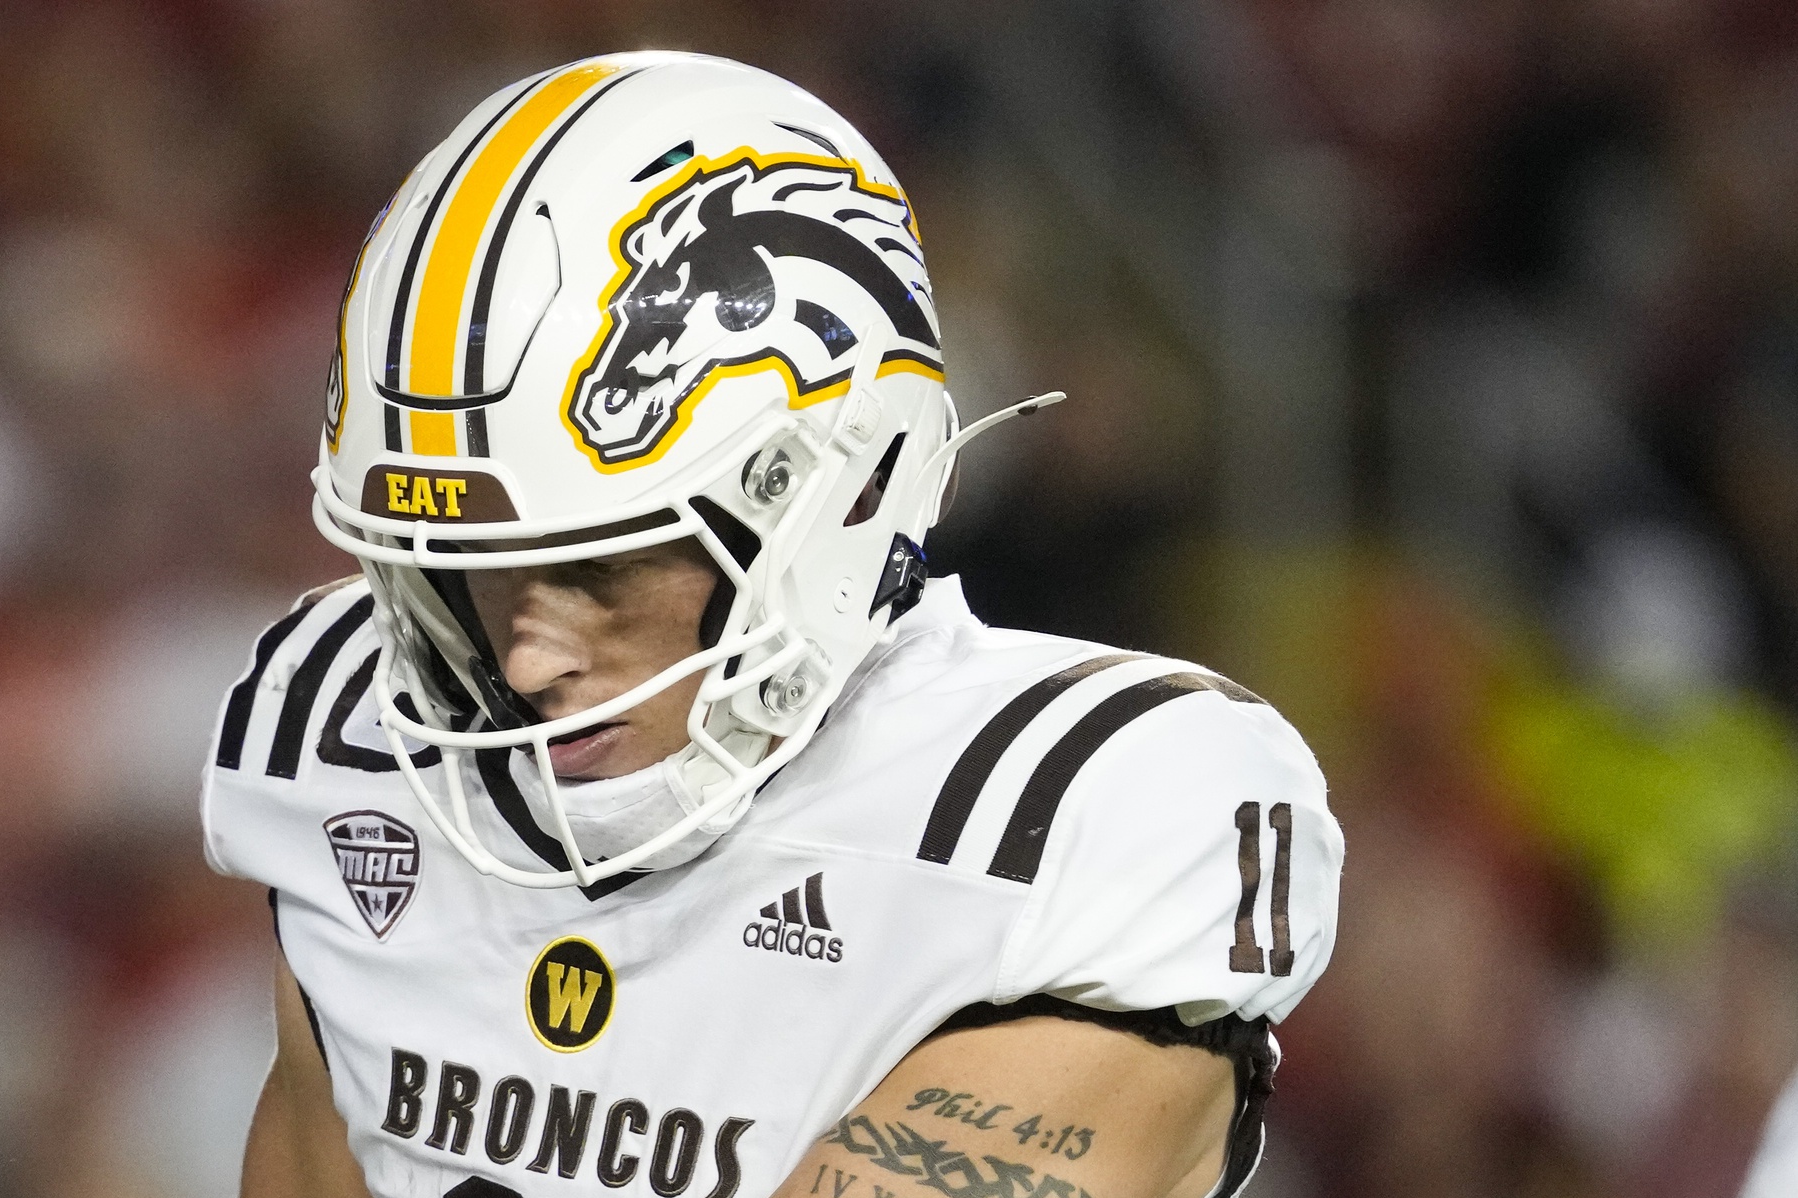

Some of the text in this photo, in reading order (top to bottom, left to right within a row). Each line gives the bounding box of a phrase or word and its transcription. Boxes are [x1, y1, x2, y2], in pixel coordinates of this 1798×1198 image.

[385, 472, 467, 518] EAT
[355, 826, 381, 840] 1946
[336, 848, 418, 882] MAC
[1229, 801, 1295, 978] 11
[743, 918, 844, 963] adidas
[546, 961, 603, 1034] W
[906, 1087, 1097, 1161] Phil 4:13
